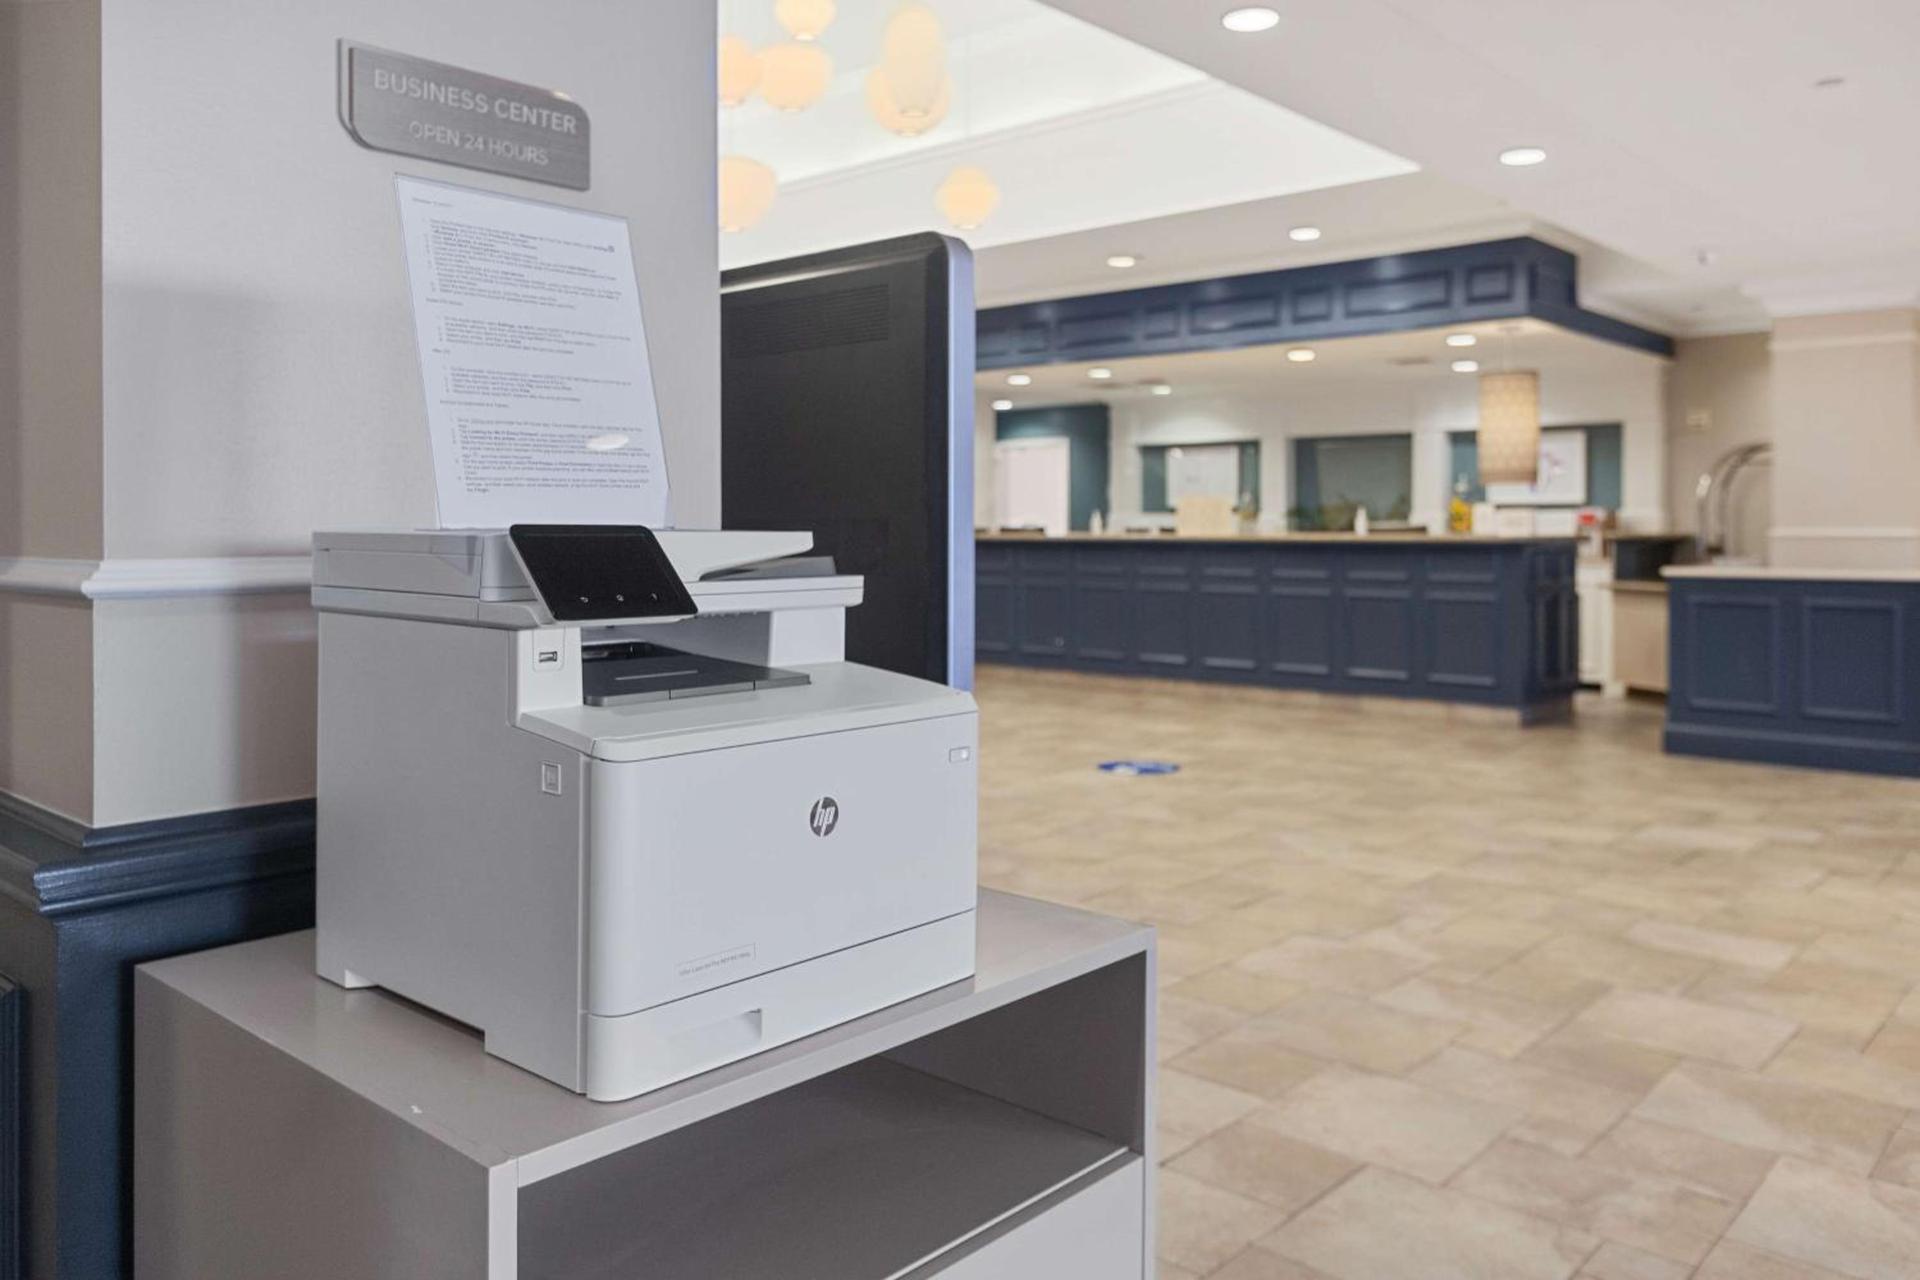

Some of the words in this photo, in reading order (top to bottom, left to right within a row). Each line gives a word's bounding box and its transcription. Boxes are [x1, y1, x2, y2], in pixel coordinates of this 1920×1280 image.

[374, 69, 488, 114] BUSINESS
[494, 98, 577, 135] CENTER
[409, 120, 459, 147] OPEN
[465, 135, 484, 151] 24
[489, 138, 549, 166] HOURS
[812, 797, 837, 837] hp
